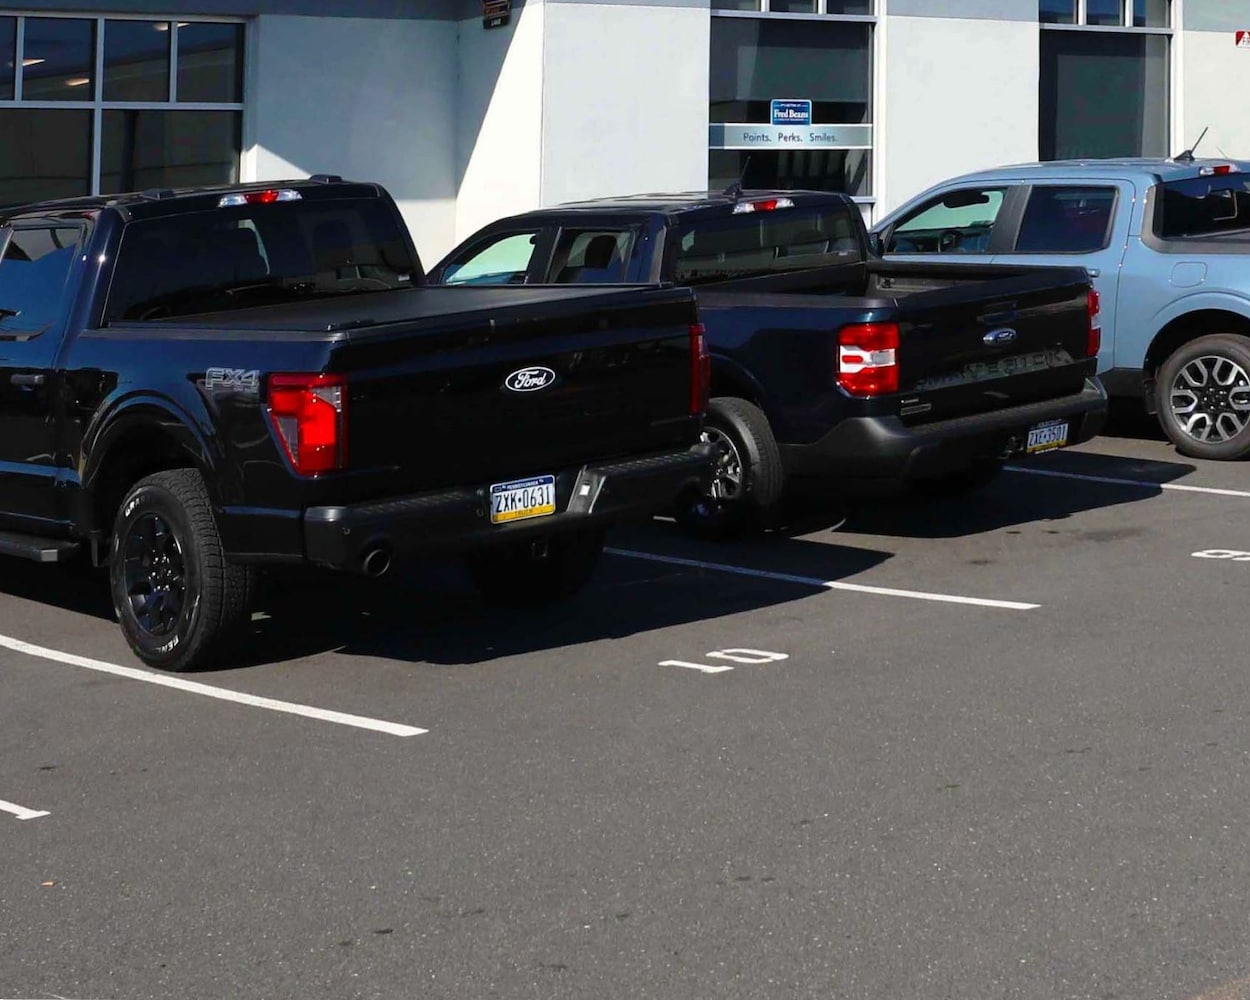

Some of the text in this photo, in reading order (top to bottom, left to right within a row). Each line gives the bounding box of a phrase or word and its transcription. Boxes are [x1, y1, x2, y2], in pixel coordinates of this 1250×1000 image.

[773, 108, 809, 118] Fred Beans
[743, 132, 838, 142] Points. Perks. Smiles.
[205, 367, 259, 390] FX4
[514, 370, 547, 389] Ford
